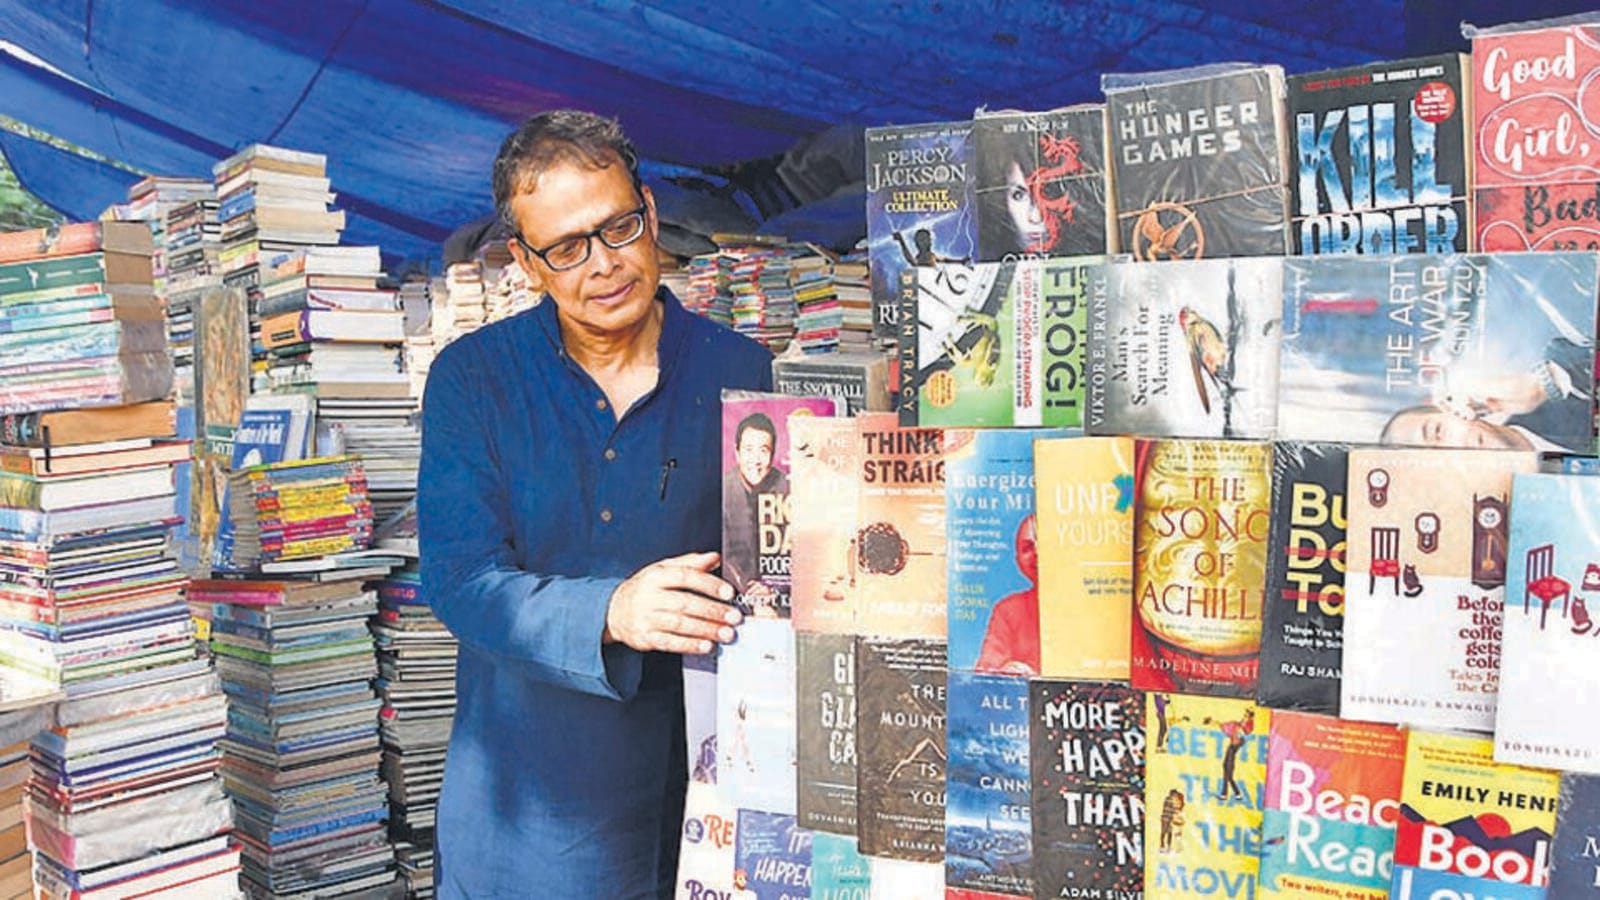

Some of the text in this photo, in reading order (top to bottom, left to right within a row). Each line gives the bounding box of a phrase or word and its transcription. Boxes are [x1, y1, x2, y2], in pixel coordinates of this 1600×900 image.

[1483, 37, 1576, 100] Good
[1120, 101, 1259, 140] HUNGER
[1124, 101, 1158, 117] THE
[1123, 130, 1242, 166] GAMES
[1493, 112, 1591, 172] Girl,
[887, 146, 949, 167] PERCY
[1296, 99, 1453, 216] KILL
[866, 163, 967, 193] JACKSON
[884, 199, 959, 213] COLLECTION
[892, 189, 950, 203] ULTIMATE
[1419, 265, 1449, 343] WAR
[1045, 265, 1077, 408] FROG!
[1386, 264, 1419, 394] THE ART
[901, 273, 915, 412] BRIAN TRACY
[1111, 327, 1130, 383] Man's
[1152, 313, 1175, 397] Meaning
[1132, 343, 1150, 407] Search
[779, 380, 864, 399] THE SNOWBALL
[1091, 363, 1107, 426] VIKTOR
[861, 431, 941, 455] THINK
[953, 493, 1000, 510] Your
[1191, 477, 1247, 502] THE
[1193, 551, 1234, 578] OF
[1471, 611, 1502, 627] the
[1466, 641, 1502, 657] gets
[1133, 656, 1221, 677] MADELINE
[1281, 662, 1305, 676] RAJ
[910, 684, 946, 700] THE
[980, 695, 1012, 710] ALL
[1044, 701, 1122, 730] MORE
[1503, 741, 1592, 759] TOSHIKAZU
[979, 776, 1031, 793] CANN
[1420, 780, 1491, 805] EMILY
[1194, 821, 1263, 857] THE
[1059, 886, 1100, 899] ADAM
